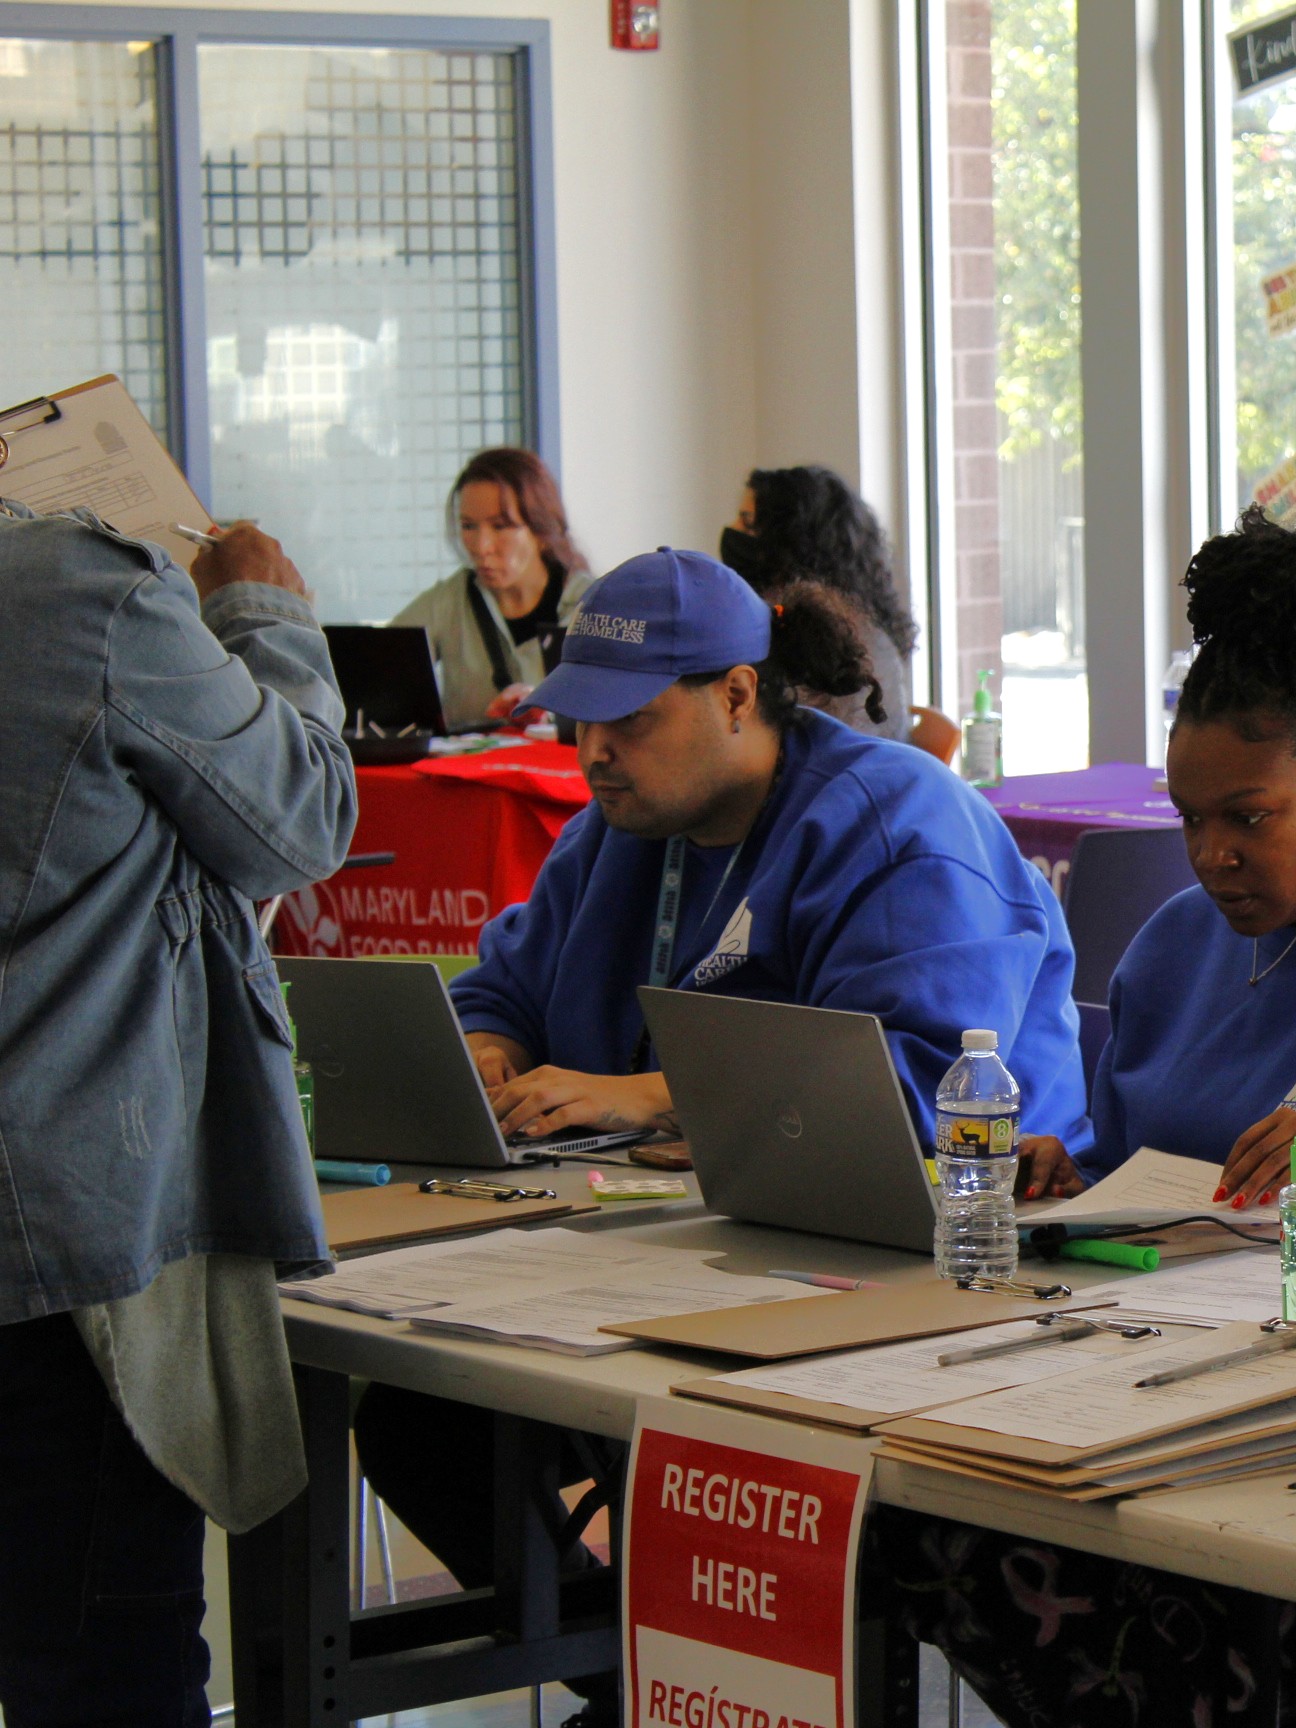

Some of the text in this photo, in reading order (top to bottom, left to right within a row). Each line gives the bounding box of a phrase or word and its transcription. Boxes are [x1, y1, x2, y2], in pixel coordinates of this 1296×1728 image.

[577, 612, 647, 632] EALTH CARE
[580, 622, 645, 645] HOMELESS
[338, 886, 490, 928] MARYLAND
[693, 964, 731, 982] CAR
[661, 1462, 823, 1545] REGISTER
[691, 1555, 778, 1622] HERE
[648, 1679, 828, 1728] REGÍSTR
